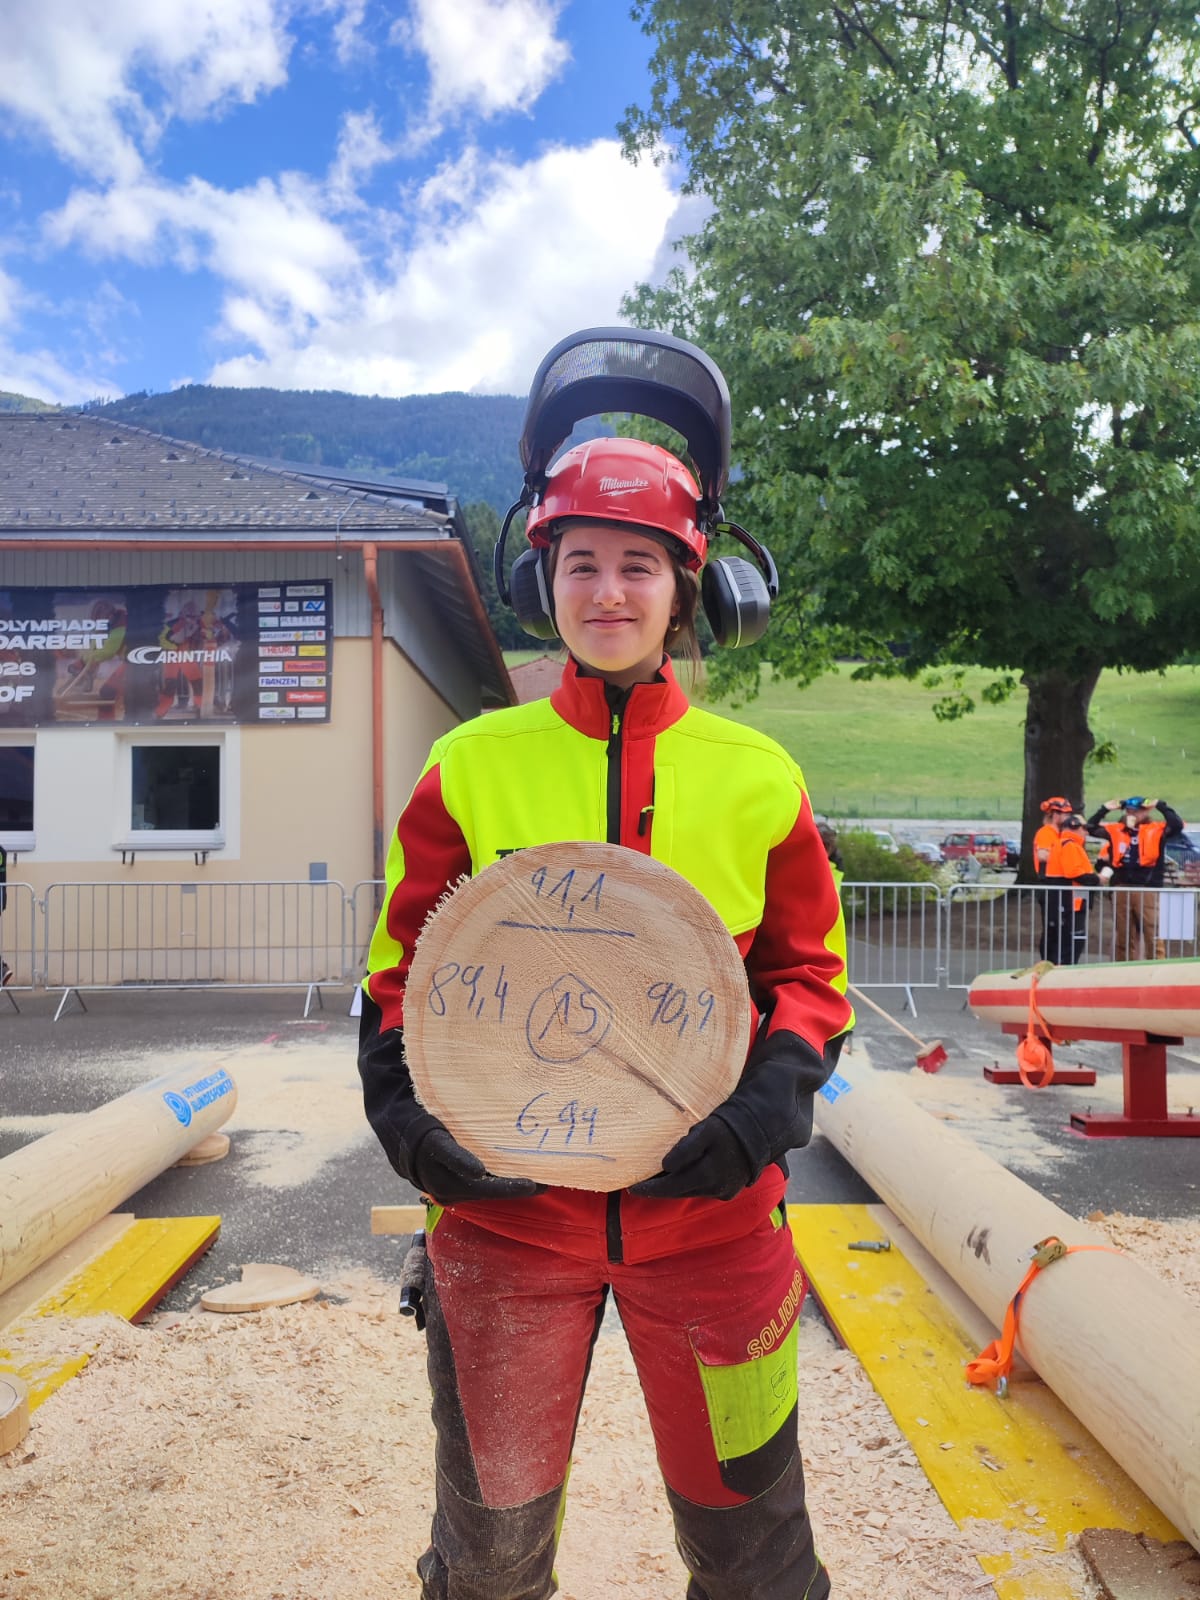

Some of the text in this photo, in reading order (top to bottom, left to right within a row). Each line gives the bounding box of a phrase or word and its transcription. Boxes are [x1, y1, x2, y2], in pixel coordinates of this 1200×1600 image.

[599, 476, 649, 491] Milwaukee
[0, 619, 109, 632] OLYMPIADE
[127, 646, 232, 664] CARINTHIA
[531, 866, 605, 923] 91,1
[428, 962, 508, 1023] 89,4
[538, 991, 598, 1041] 15
[647, 981, 716, 1037] 90,9
[747, 1270, 803, 1360] SOLIDUR
